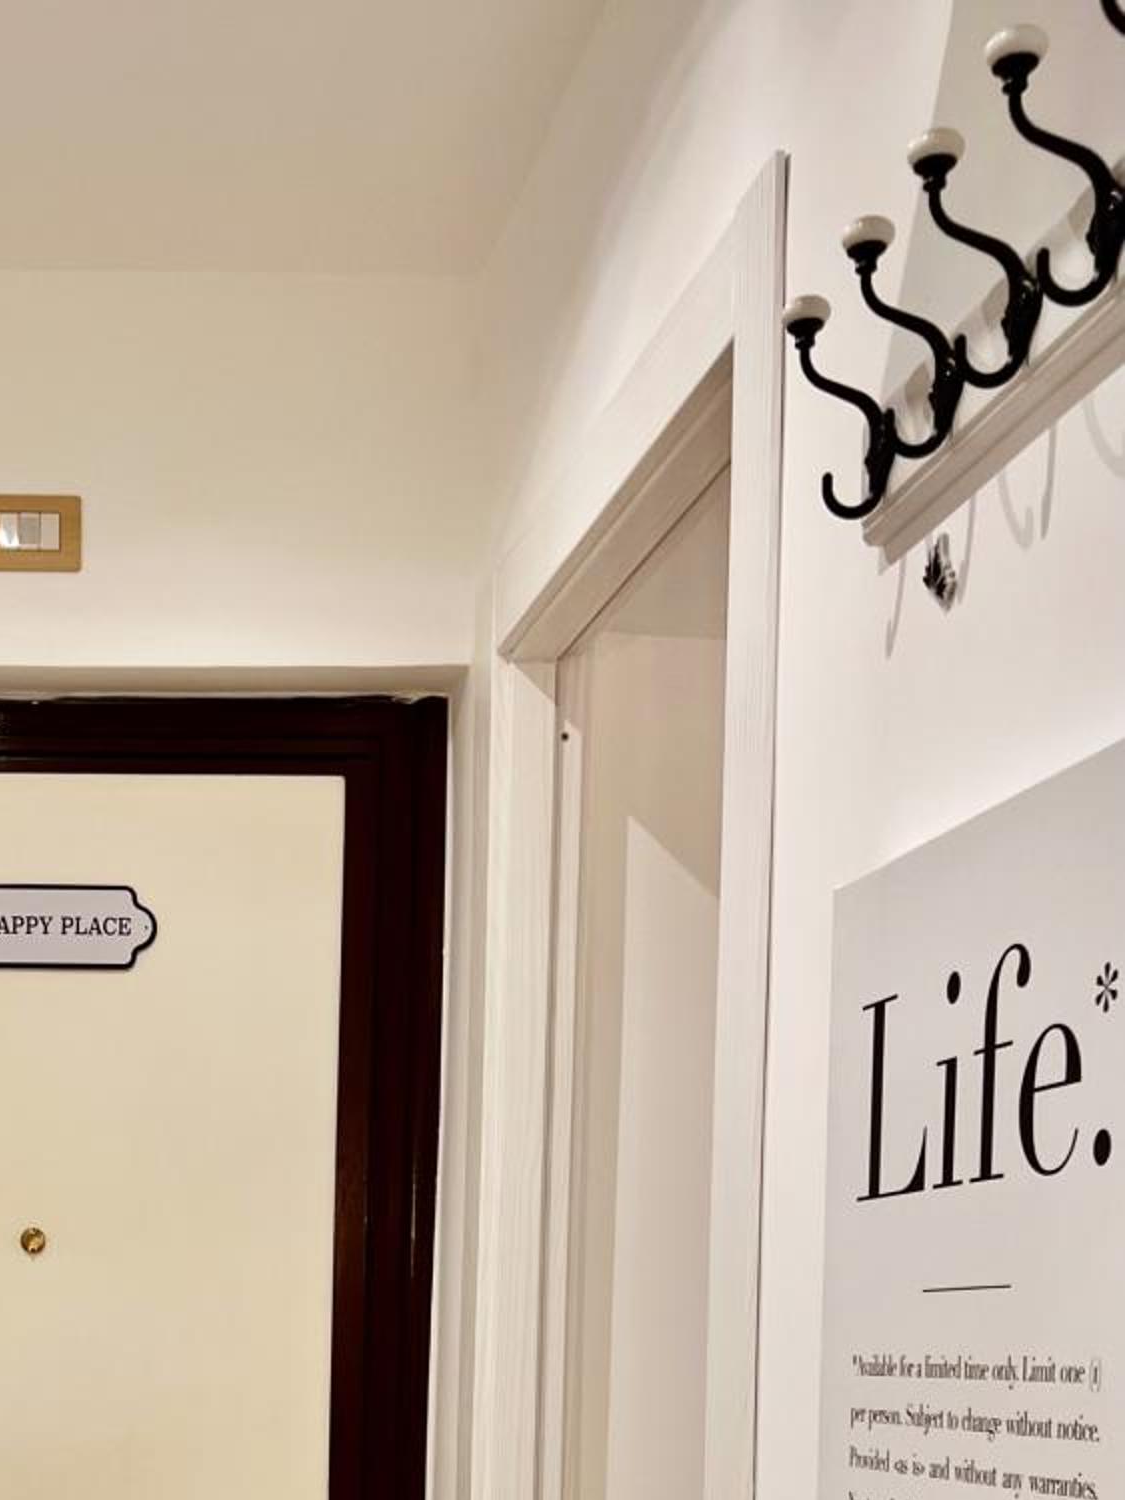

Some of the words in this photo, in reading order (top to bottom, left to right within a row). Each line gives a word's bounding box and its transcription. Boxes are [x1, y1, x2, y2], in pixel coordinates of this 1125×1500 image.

[61, 916, 132, 936] PLACE
[899, 1353, 914, 1378] for
[916, 1363, 922, 1378] a
[925, 1354, 962, 1379] limited
[964, 1354, 990, 1381] time
[992, 1353, 1019, 1390] only.
[1022, 1355, 1056, 1384] Limit
[1060, 1365, 1086, 1383] one
[850, 1407, 866, 1429] per
[868, 1408, 903, 1432] person.
[905, 1403, 944, 1435] Subject
[946, 1410, 959, 1430] to
[960, 1407, 1002, 1442] change
[1006, 1411, 1052, 1439] without
[1056, 1414, 1100, 1442] notice.
[849, 1445, 890, 1473] Provided
[928, 1456, 950, 1480] and
[954, 1459, 997, 1487] without
[1002, 1472, 1023, 1499] any
[1028, 1472, 1099, 1500] warranties.
